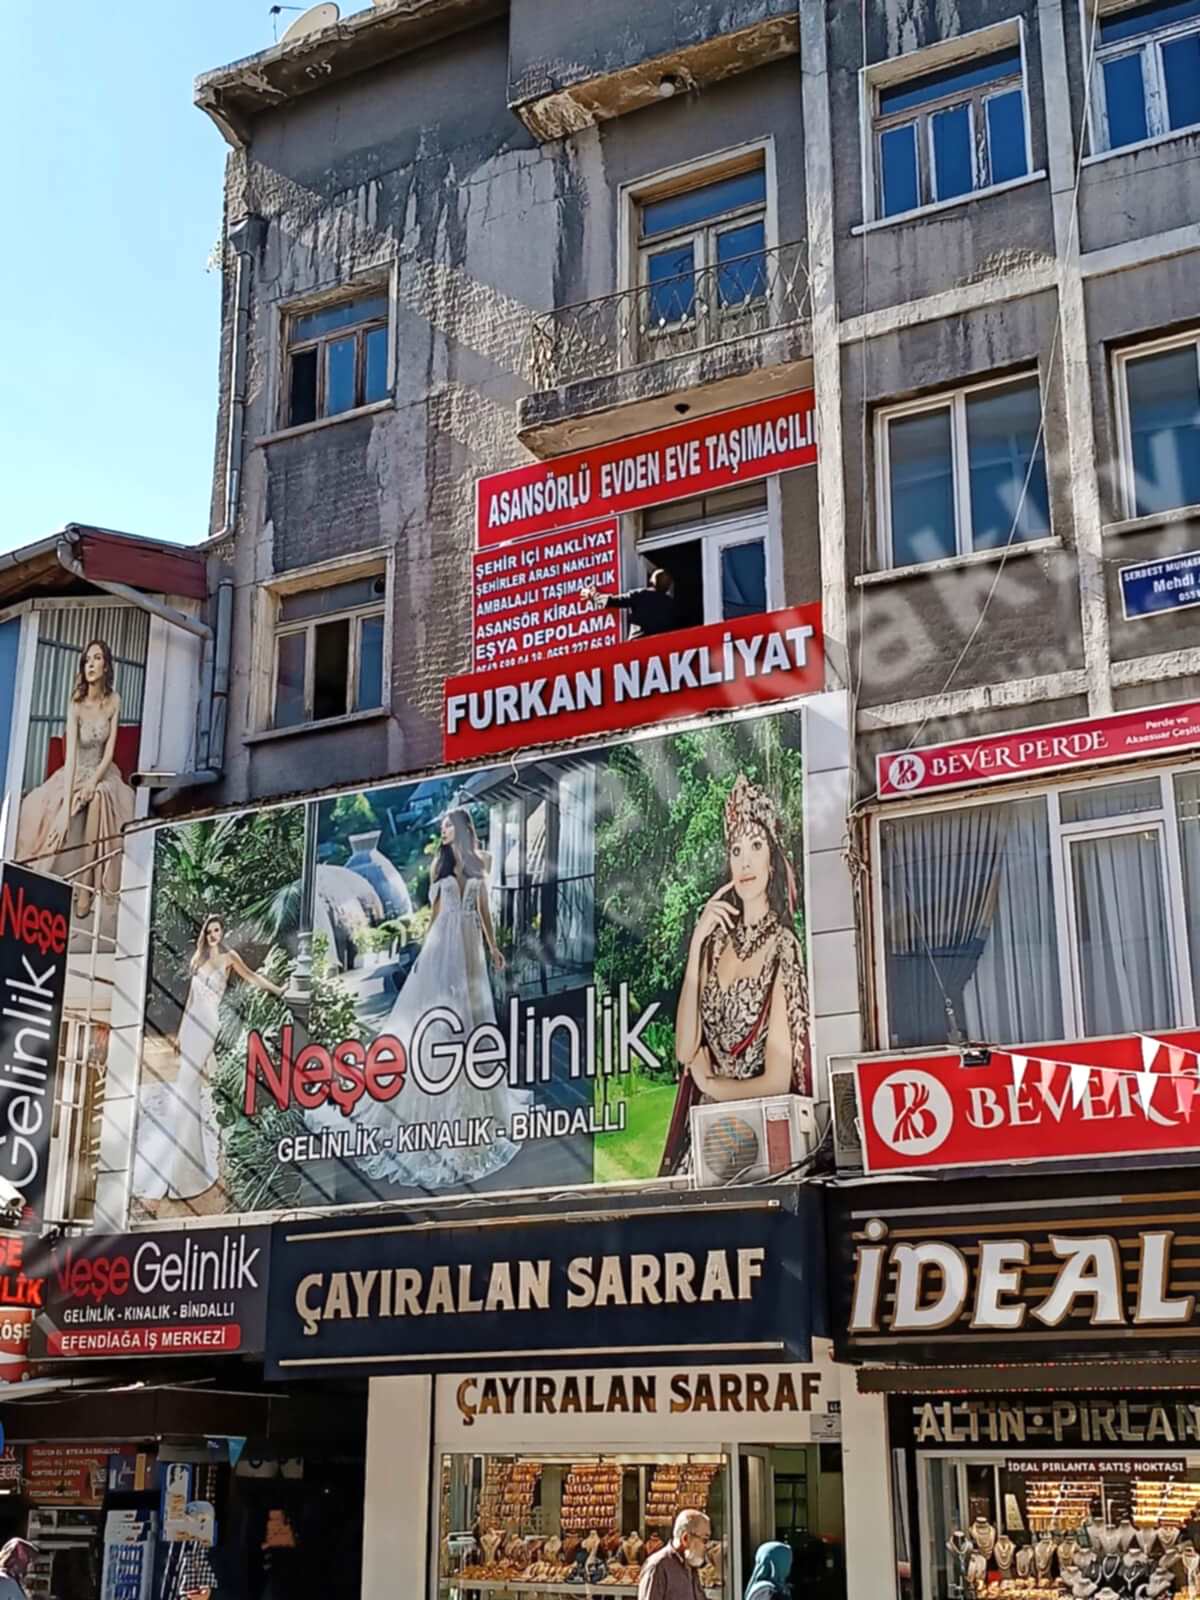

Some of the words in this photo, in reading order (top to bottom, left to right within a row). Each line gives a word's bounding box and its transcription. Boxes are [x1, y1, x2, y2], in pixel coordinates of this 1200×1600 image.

[488, 463, 591, 528] ASANSÖRLÜ
[601, 453, 660, 499] EVDEN
[665, 441, 700, 482] EVE
[475, 551, 517, 580] ŞEHİR
[521, 547, 540, 569] İÇİ
[544, 529, 614, 559] NAKLİYAT
[476, 571, 526, 598] ŞEHİRLER
[529, 564, 560, 582] ARASI
[563, 550, 614, 574] NAKLİYAT
[476, 589, 539, 616] AMBALAJLI
[542, 570, 615, 600] TAŞIMACILIK
[1153, 573, 1194, 593] Mehdi
[476, 611, 540, 640] ASANSÖR
[476, 638, 518, 661] EŞYA
[522, 613, 616, 648] DEPOLAMA
[447, 667, 602, 734] FURKAN
[613, 625, 814, 702] NAKLİYAT
[929, 744, 1017, 777] BEVER
[1019, 730, 1109, 763] PERDE
[0, 882, 67, 955] Neşe
[243, 1024, 407, 1117] Neşe
[410, 981, 662, 1095] Gelinlik
[277, 1123, 378, 1163] GELİNLİK
[396, 1118, 491, 1153] KINALIK
[511, 1101, 626, 1140] BİNDALLI
[53, 1248, 129, 1302] Neşe
[133, 1234, 260, 1294] Gelinlik
[295, 1260, 551, 1336] ÇAYIRALAN
[566, 1247, 765, 1308] SARRAF
[848, 1218, 1196, 1332] İDEAL
[63, 1305, 115, 1323] GELİNLİK
[124, 1304, 170, 1321] KINALIK
[180, 1301, 235, 1319] BİNDALLI
[61, 1329, 141, 1350] EFENDİAĞA
[144, 1328, 158, 1349] İŞ
[161, 1327, 226, 1346] MERKEZİ
[456, 1375, 657, 1426] ÇAYIRALAN
[669, 1372, 822, 1413] SARRAF
[915, 1401, 1025, 1442] ALTIN
[1008, 1461, 1038, 1472] İDEAL
[1042, 1462, 1096, 1472] PIRLANTA
[1099, 1462, 1131, 1473] SATIŞ
[1134, 1462, 1184, 1472] NOKTASI
